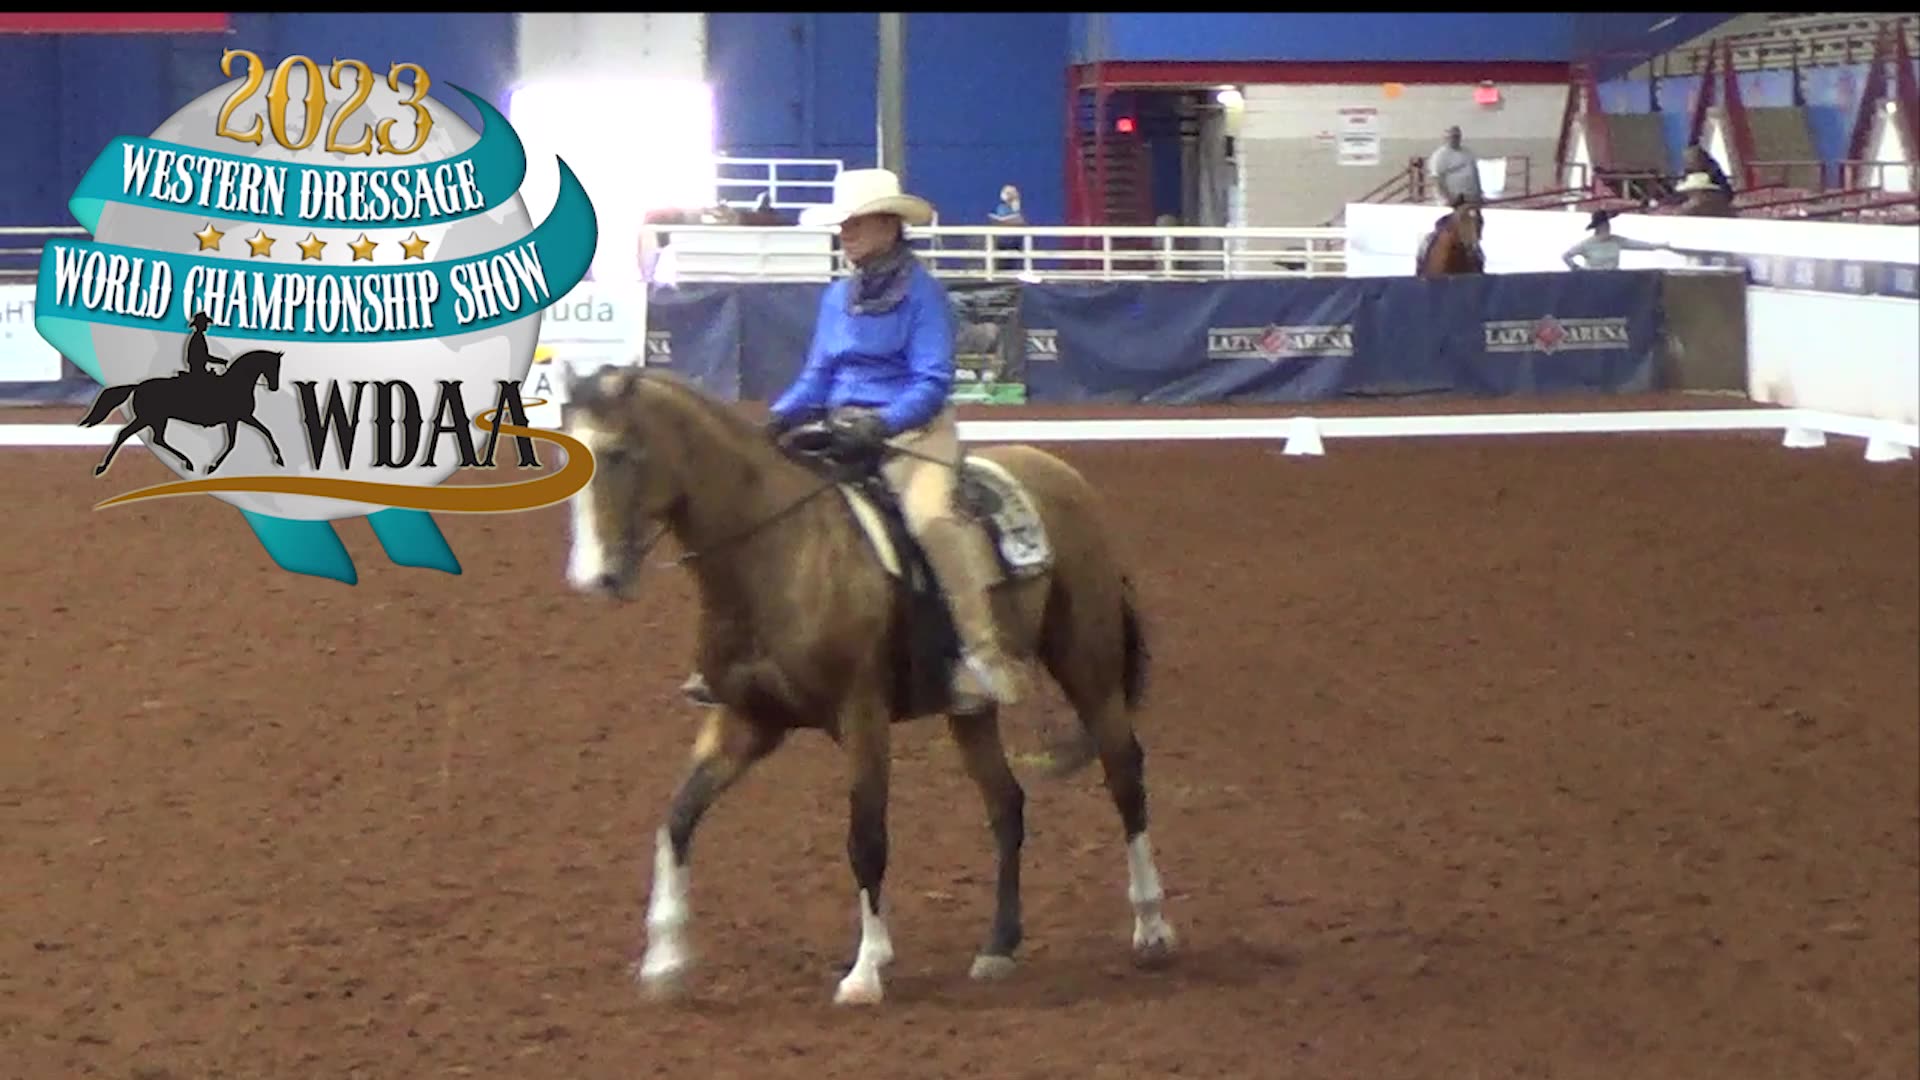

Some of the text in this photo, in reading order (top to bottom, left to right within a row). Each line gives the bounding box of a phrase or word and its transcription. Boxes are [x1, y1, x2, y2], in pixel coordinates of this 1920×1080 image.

[1208, 333, 1353, 351] LAZY ARENA
[1486, 325, 1629, 345] LAZY ARENA
